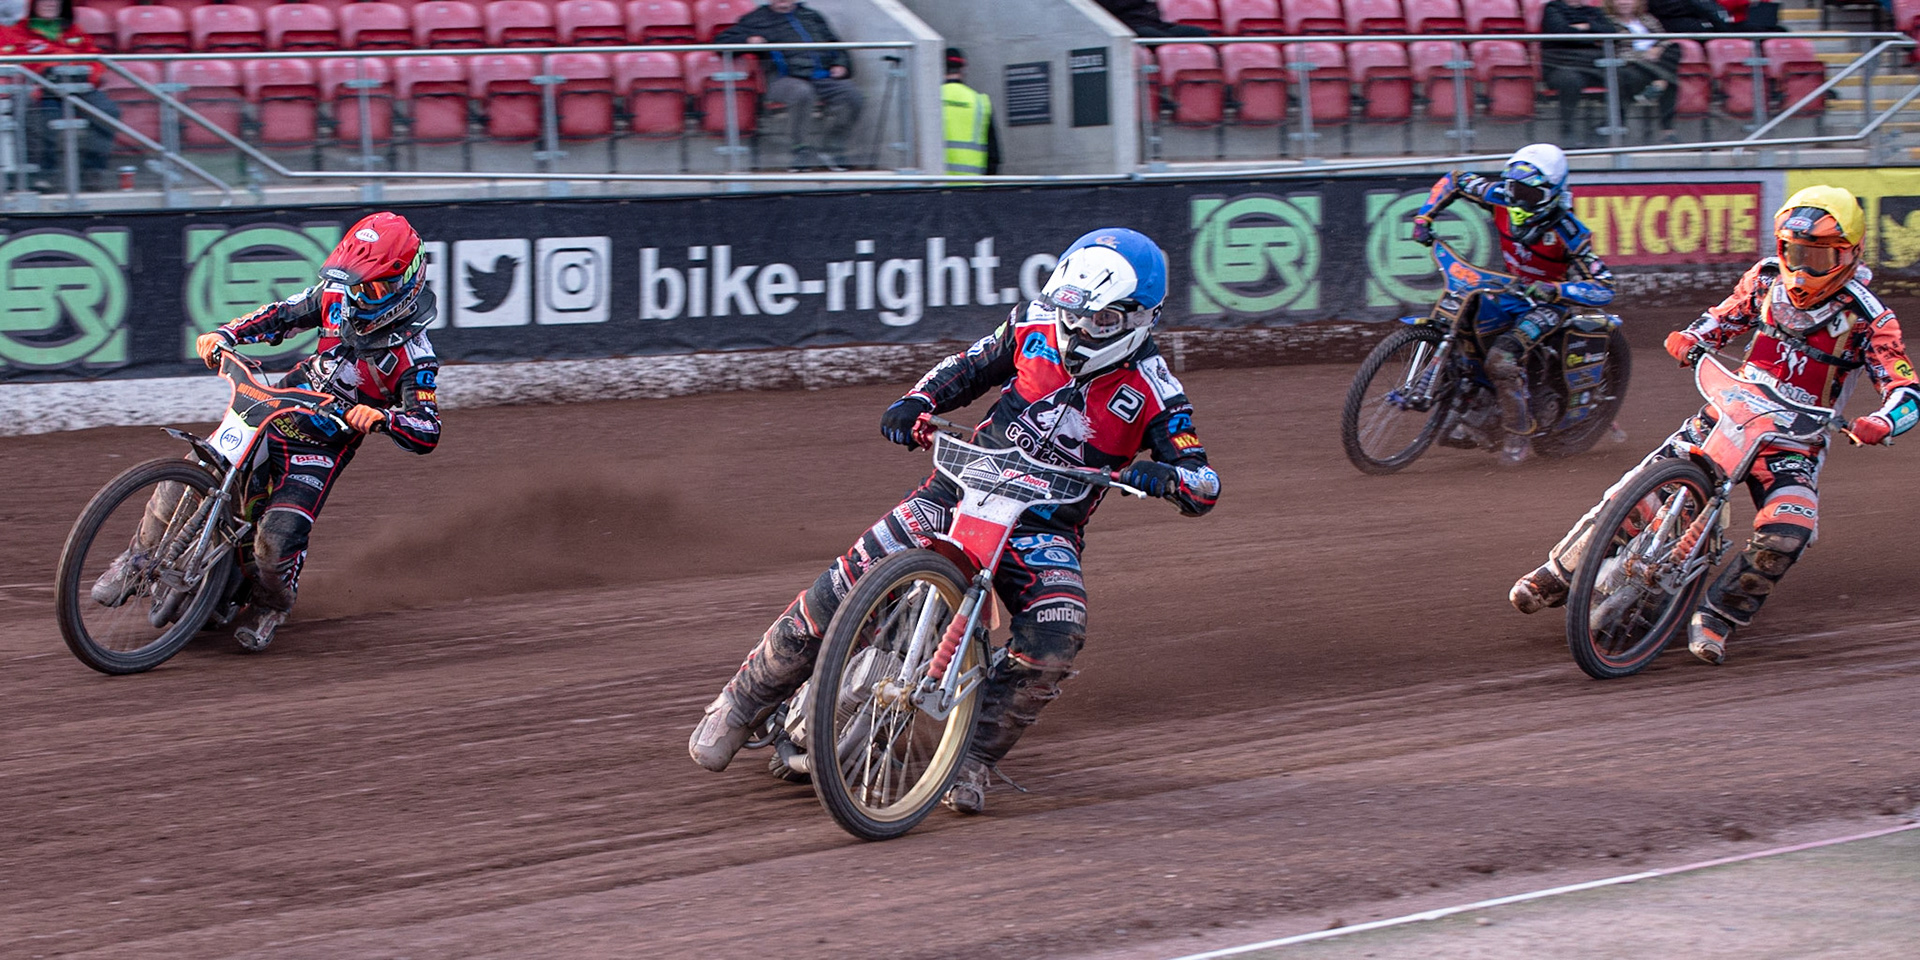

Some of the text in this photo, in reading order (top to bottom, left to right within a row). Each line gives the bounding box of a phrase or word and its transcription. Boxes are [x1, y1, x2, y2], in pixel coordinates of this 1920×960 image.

[1576, 194, 1757, 255] HYCOTE
[640, 236, 1062, 327] bike-right.c
[418, 390, 436, 401] HYC
[1111, 389, 1139, 420] 2
[1006, 422, 1078, 469] COLT
[1174, 433, 1200, 448] HYC
[295, 454, 331, 465] BELL
[1022, 474, 1049, 489] Doors
[1772, 503, 1816, 519] pod
